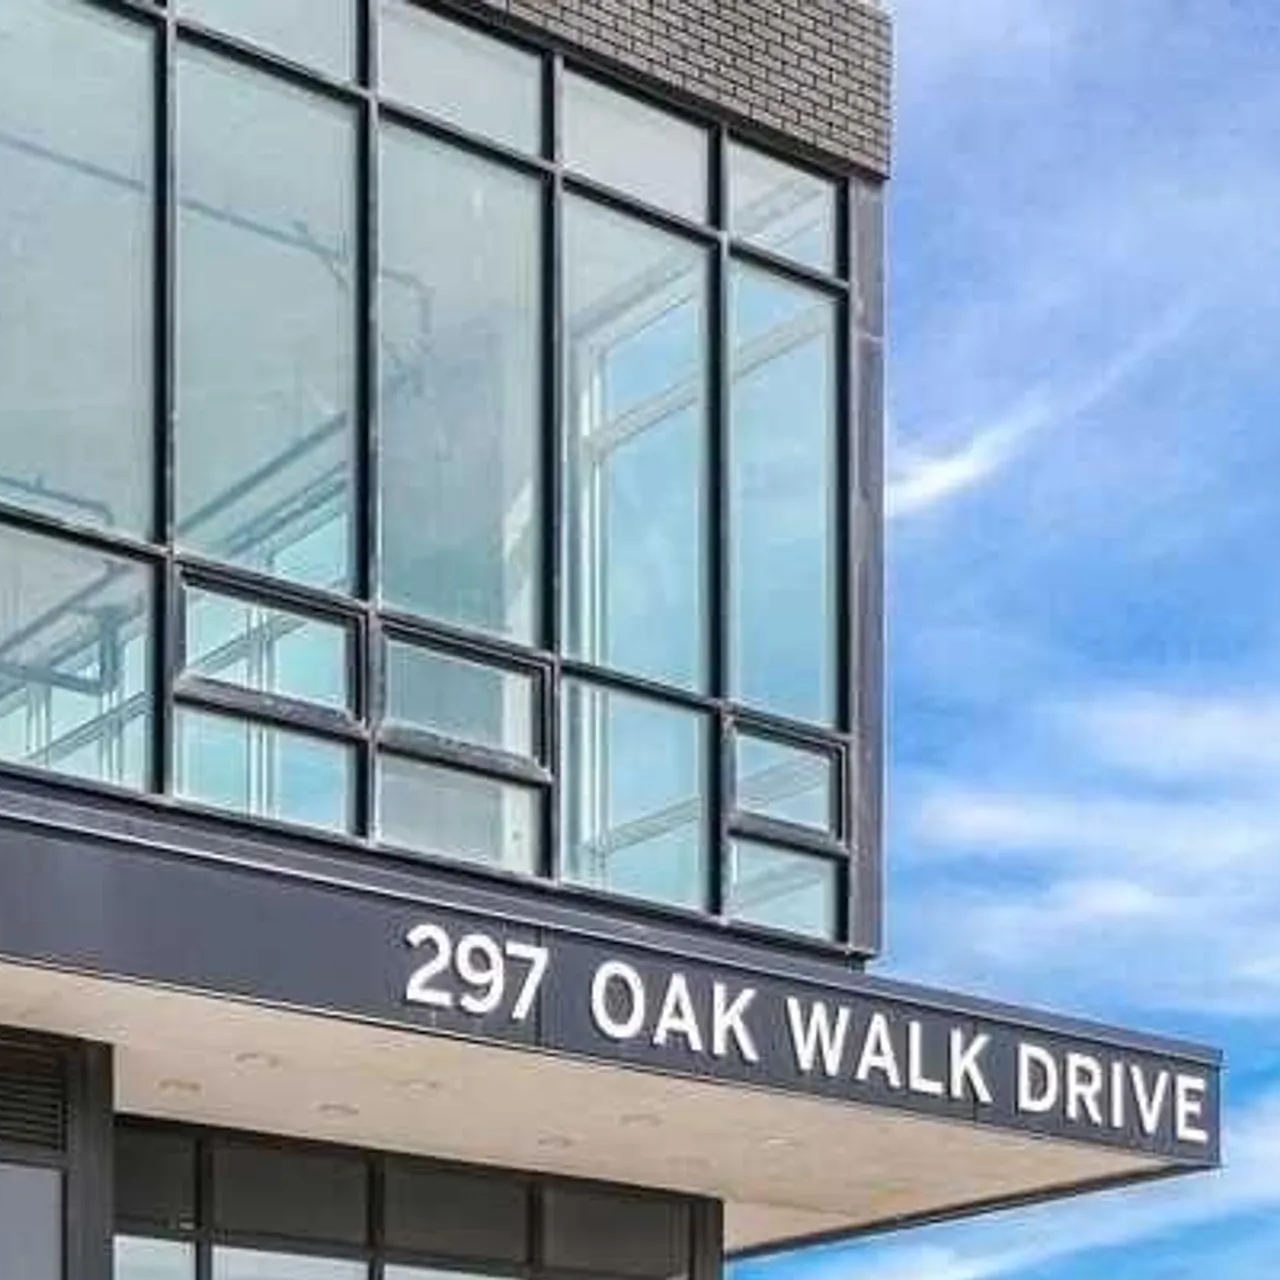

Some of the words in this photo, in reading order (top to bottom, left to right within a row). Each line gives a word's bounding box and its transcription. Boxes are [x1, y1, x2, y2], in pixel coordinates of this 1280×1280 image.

[405, 923, 548, 1021] 297
[590, 960, 759, 1063] OAK
[787, 997, 993, 1105] WALK
[1016, 1041, 1210, 1145] DRIVE
